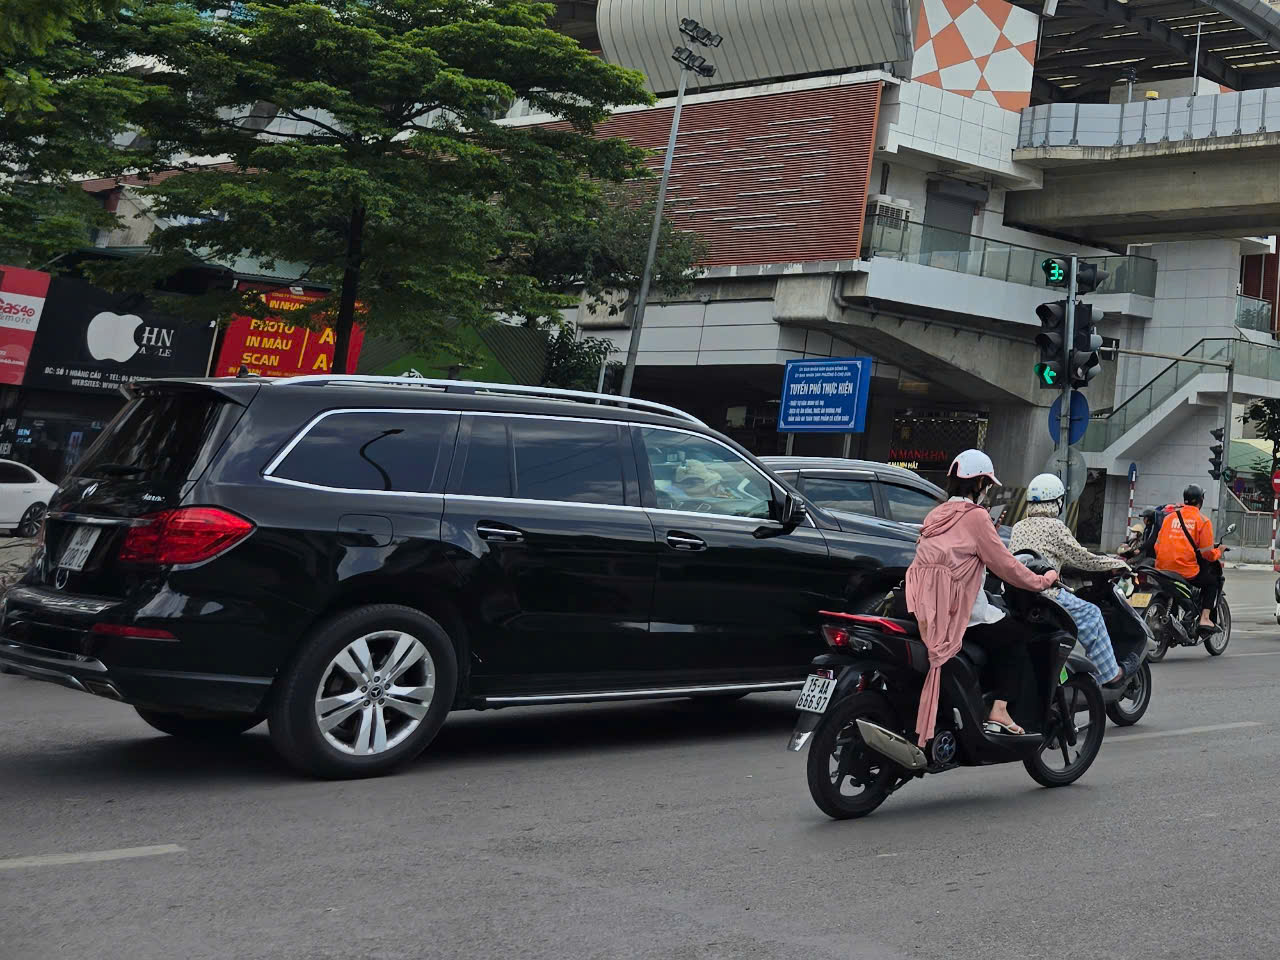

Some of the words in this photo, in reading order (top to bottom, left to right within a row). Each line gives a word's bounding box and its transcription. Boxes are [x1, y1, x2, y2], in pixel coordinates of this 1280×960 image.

[141, 327, 174, 346] HN
[246, 336, 260, 347] IN
[261, 337, 292, 350] MÀU
[242, 352, 280, 366] SCAN
[790, 380, 808, 395] TUYẾN
[809, 379, 822, 394] PHỐ
[822, 382, 837, 396] THỰC
[838, 380, 853, 396] HIỆN
[807, 678, 831, 695] 15-AA
[797, 693, 828, 711] 666.97
